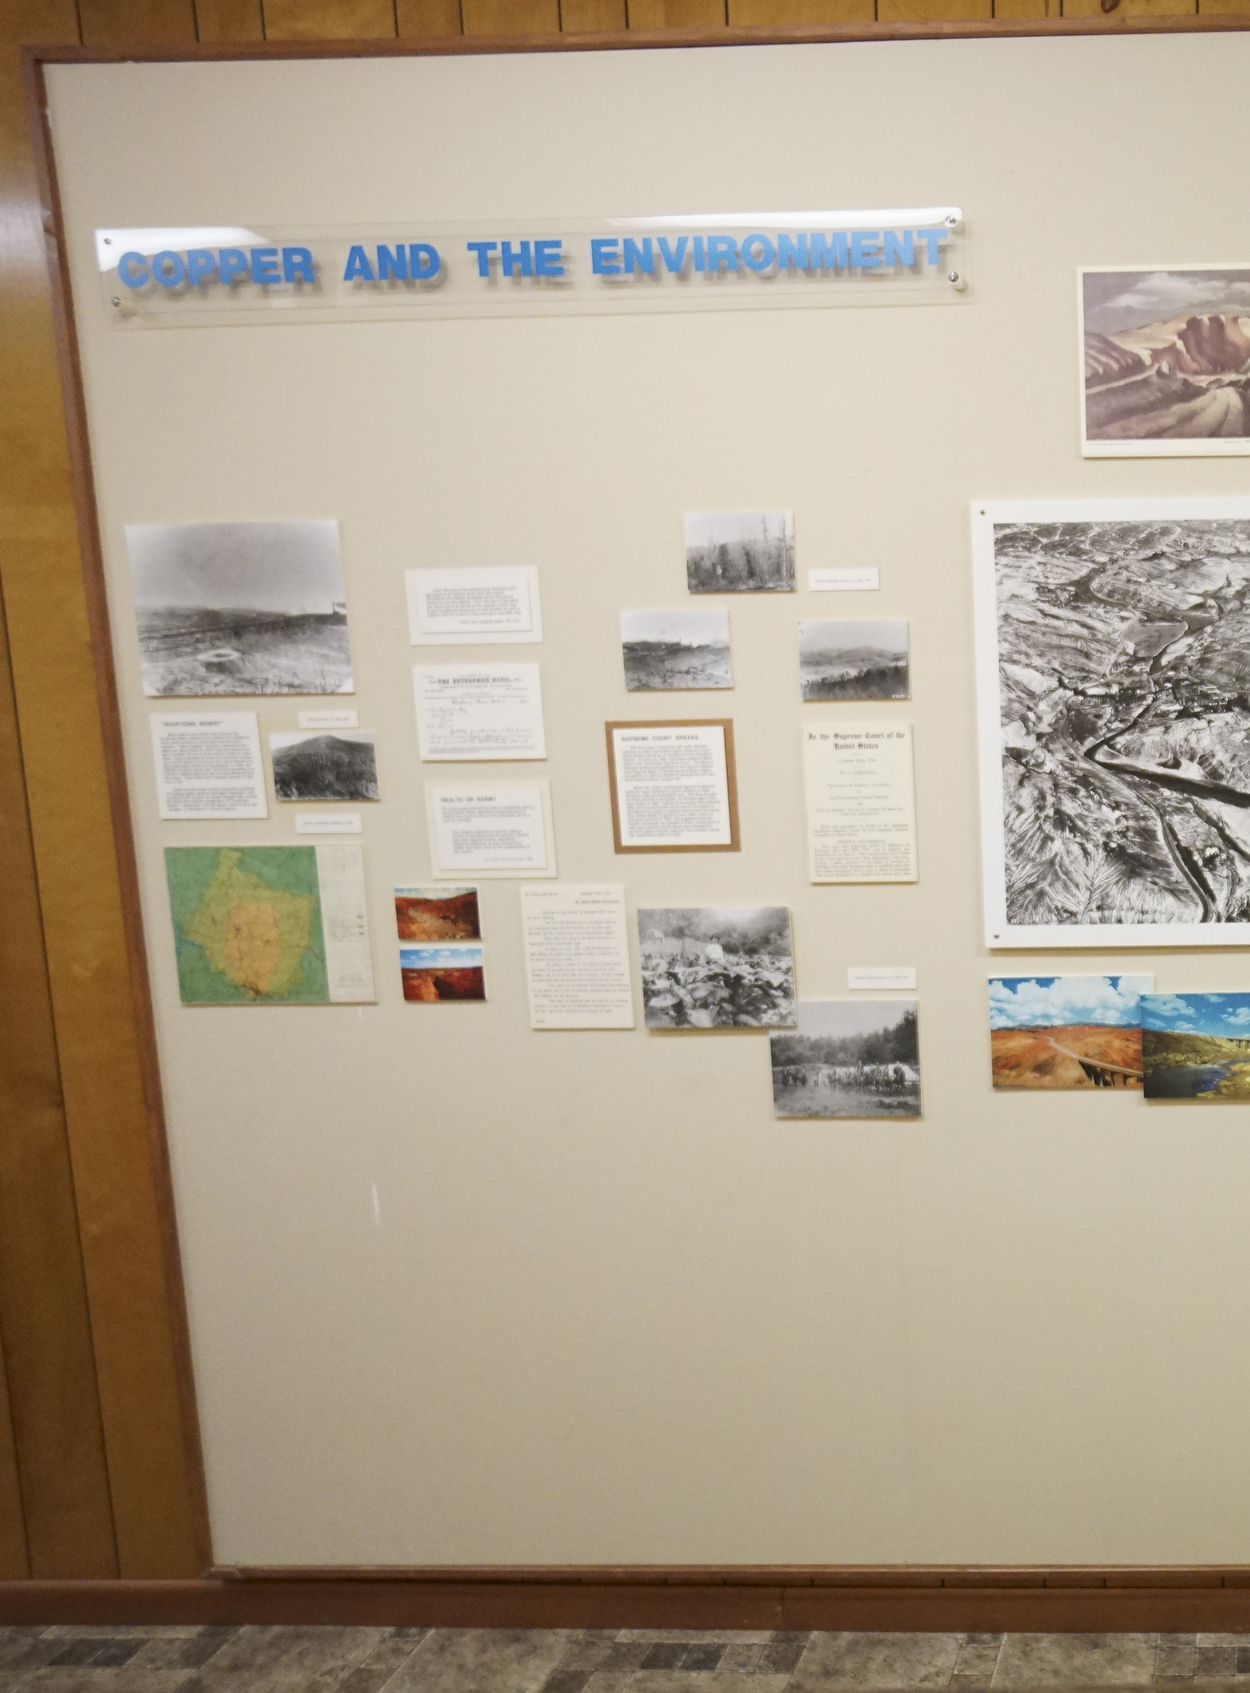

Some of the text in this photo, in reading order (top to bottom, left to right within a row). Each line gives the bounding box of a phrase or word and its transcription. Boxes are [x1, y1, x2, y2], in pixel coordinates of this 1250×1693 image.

[118, 229, 949, 288] COPPER AND THE ENVIRONMENT
[820, 733, 831, 741] the
[834, 732, 863, 742] Supreme
[865, 731, 885, 740] Court
[887, 731, 894, 739] of
[896, 731, 906, 741] the
[834, 741, 879, 750] United States
